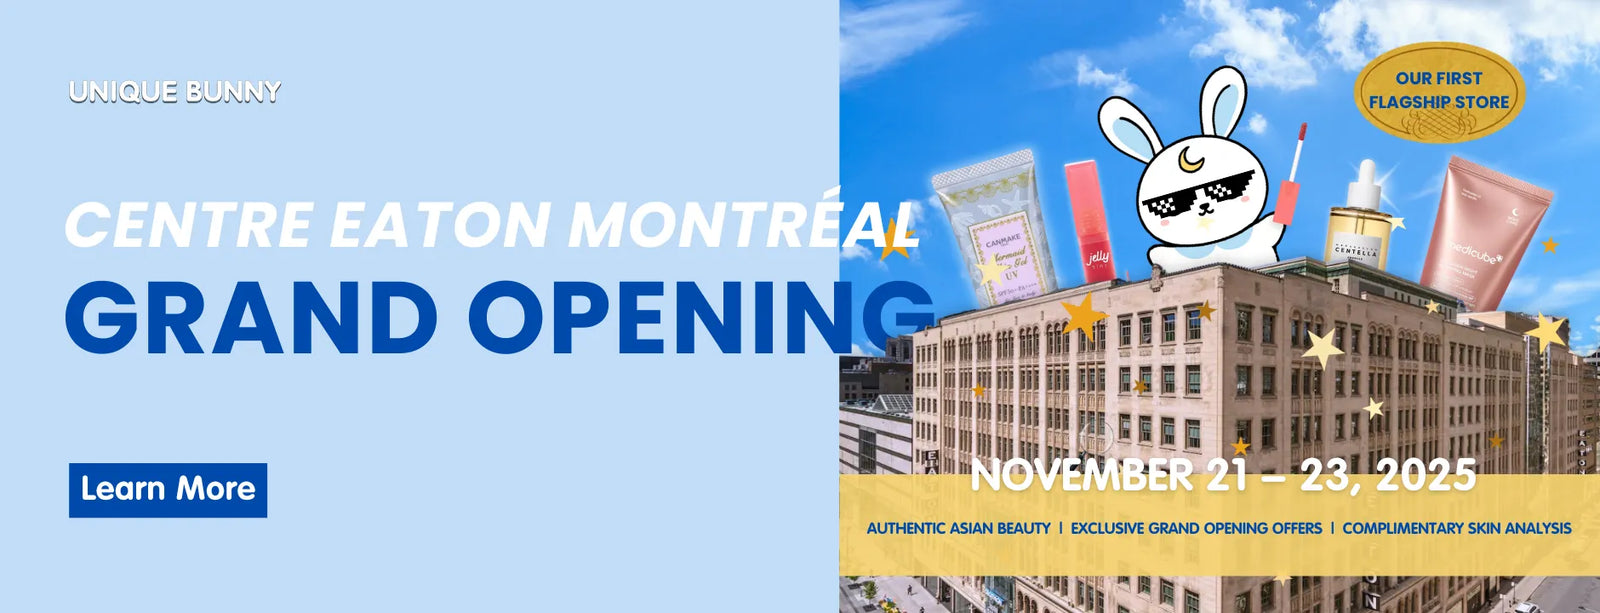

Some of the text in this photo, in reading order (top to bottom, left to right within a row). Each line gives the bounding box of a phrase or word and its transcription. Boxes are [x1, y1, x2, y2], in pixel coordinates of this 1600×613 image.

[985, 233, 1021, 248] CANMAKE
[1086, 250, 1109, 266] jelly
[1335, 246, 1377, 257] CENTELLA
[1005, 270, 1019, 281] UV
